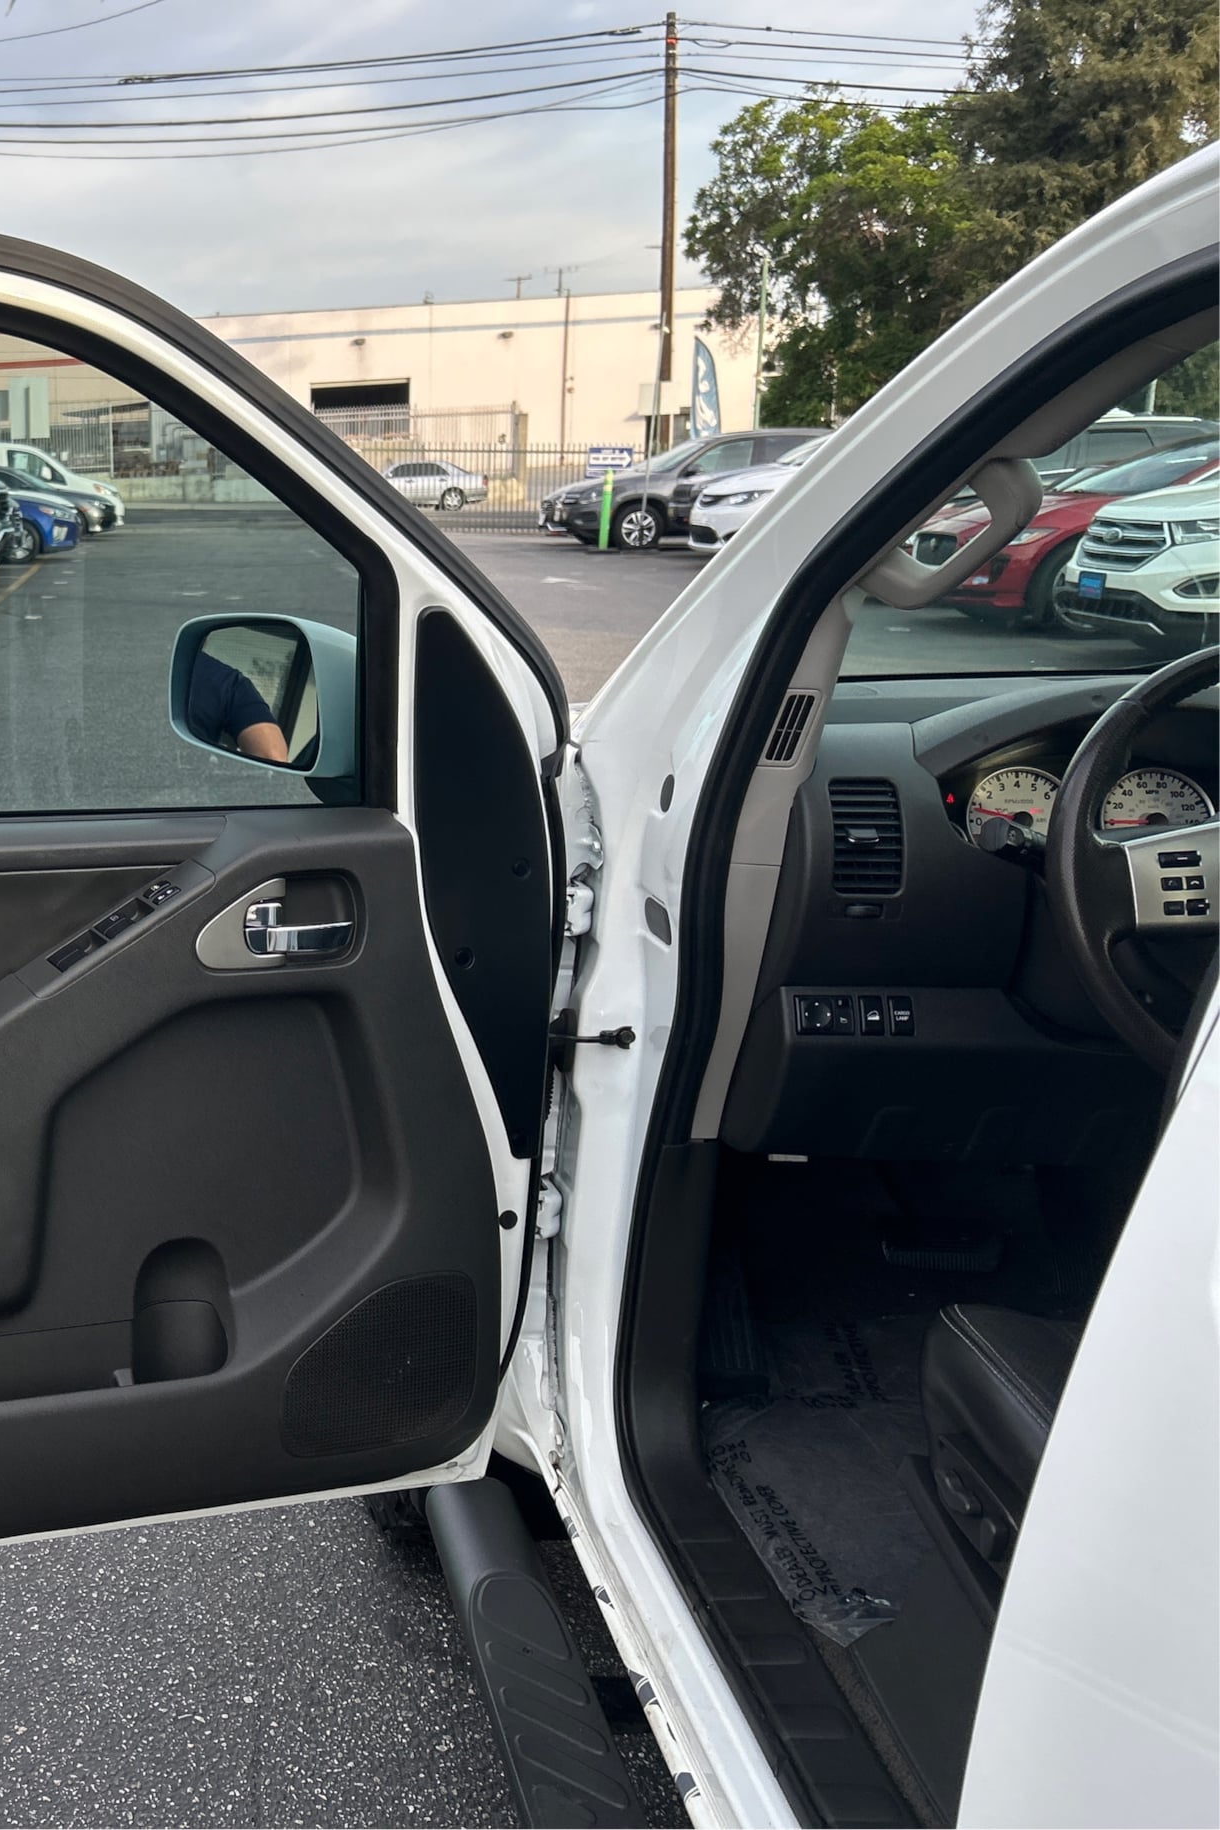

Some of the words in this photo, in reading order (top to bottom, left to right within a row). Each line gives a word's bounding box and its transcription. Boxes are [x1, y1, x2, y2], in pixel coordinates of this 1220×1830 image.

[999, 783, 1005, 792] 3
[1013, 780, 1021, 789] 4
[1031, 783, 1038, 792] 5
[1136, 781, 1148, 789] 60
[1155, 781, 1168, 789] 80
[986, 791, 993, 800] 2
[1043, 791, 1051, 800] 6
[1121, 789, 1133, 797] 40
[1112, 802, 1124, 810] 20
[1181, 804, 1196, 812] 120
[975, 817, 983, 826] 0
[755, 1484, 789, 1517] COVER
[750, 1509, 781, 1541] MUST
[781, 1518, 838, 1584] PROTECTIVE
[775, 1546, 813, 1589] DEALER
